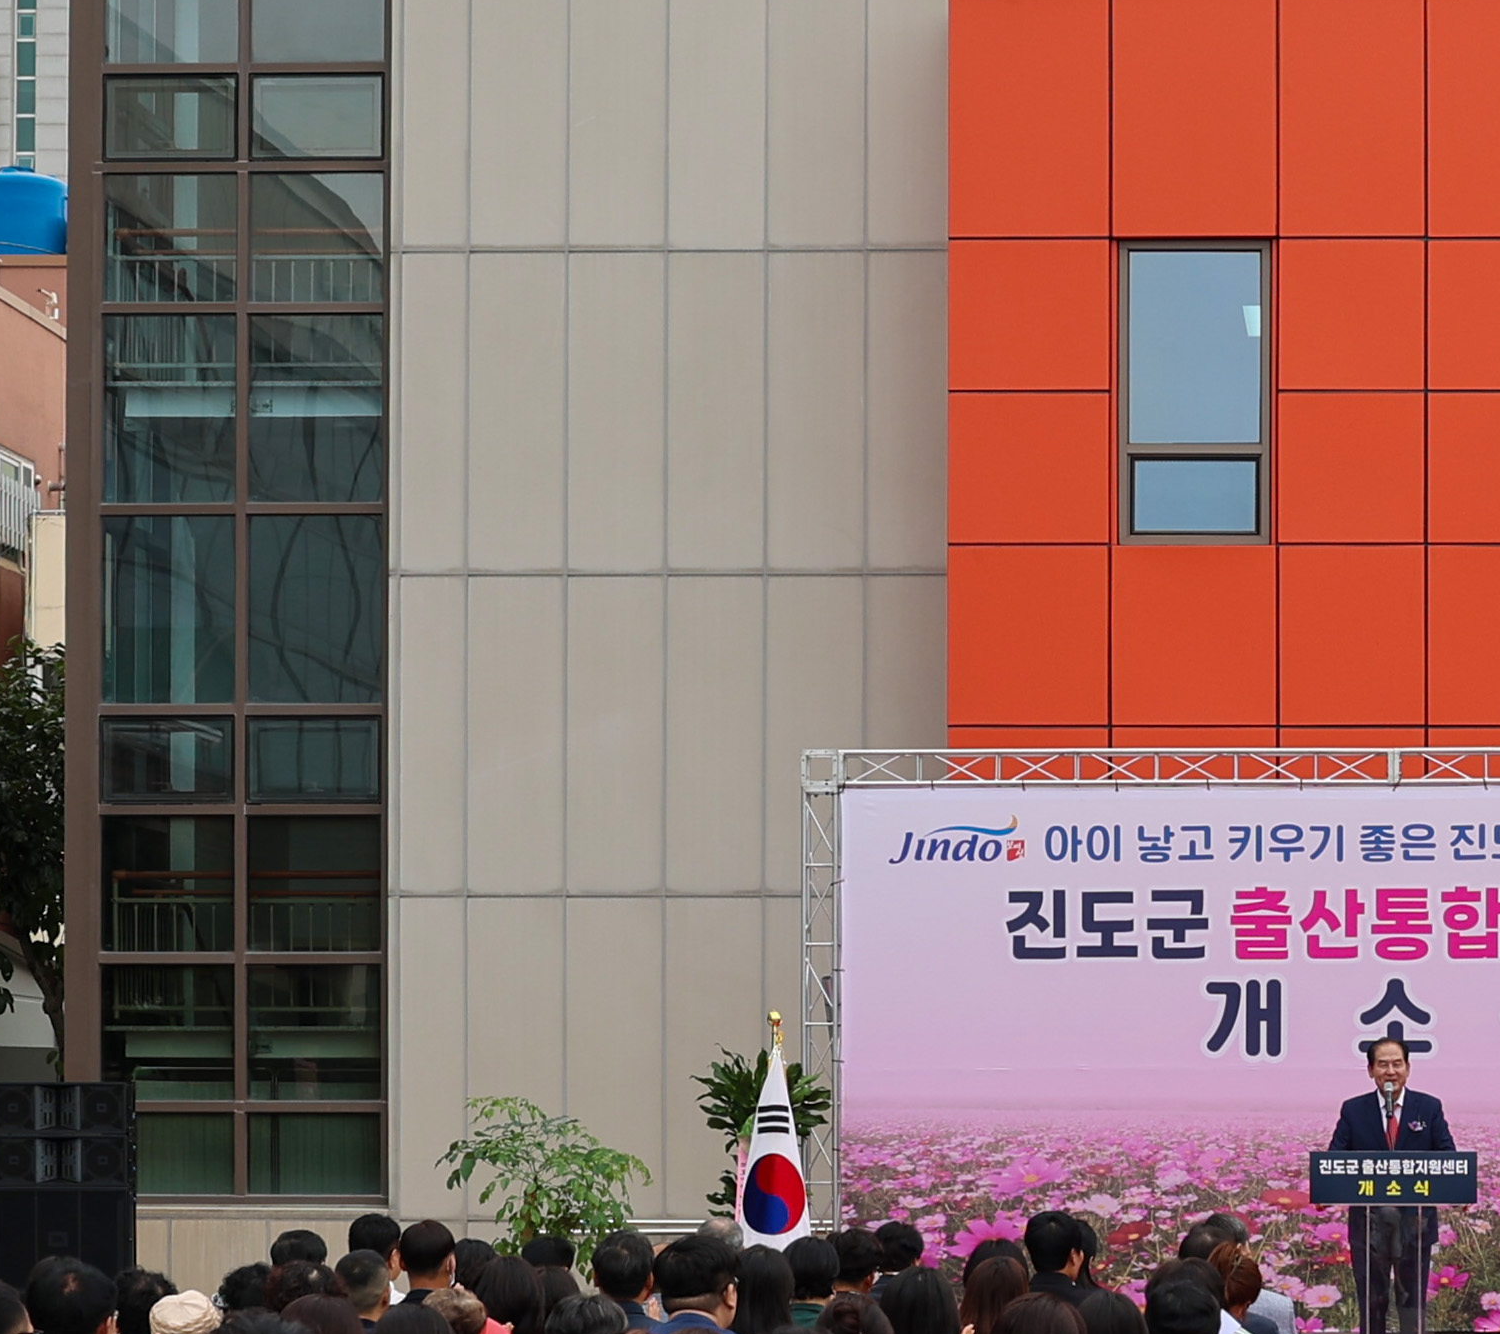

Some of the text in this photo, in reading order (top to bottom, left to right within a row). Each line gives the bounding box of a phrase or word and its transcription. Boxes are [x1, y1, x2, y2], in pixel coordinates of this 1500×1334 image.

[889, 832, 1002, 864] Jindo
[1044, 824, 1122, 863] 아이
[1137, 824, 1215, 863] 낳고
[1228, 823, 1344, 863] 키우기
[1359, 823, 1437, 863] 좋은
[1005, 888, 1210, 961] 진도군
[1319, 1159, 1468, 1175] 진도군 출산통합지원센터
